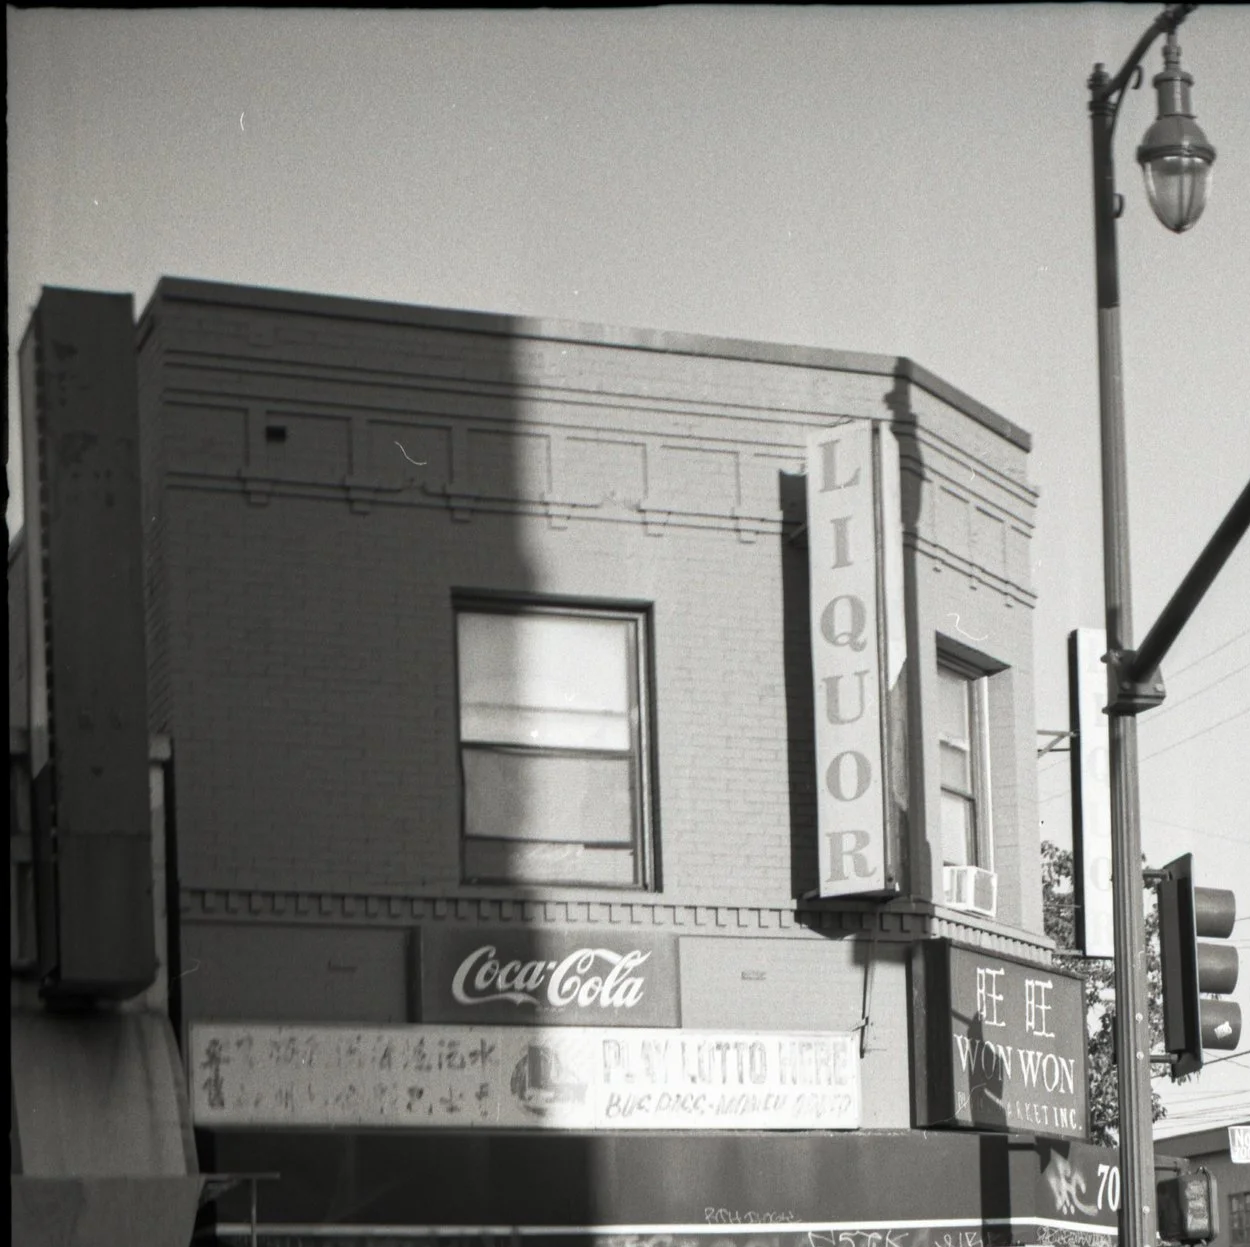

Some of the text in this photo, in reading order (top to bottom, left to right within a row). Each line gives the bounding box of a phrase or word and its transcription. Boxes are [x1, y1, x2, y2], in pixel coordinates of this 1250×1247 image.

[817, 439, 877, 883] LIQUOR
[452, 944, 651, 1009] Coca-Cola
[680, 1038, 767, 1085] LOTTO
[953, 1034, 1075, 1095] WON WON
[1052, 1107, 1083, 1131] INC.
